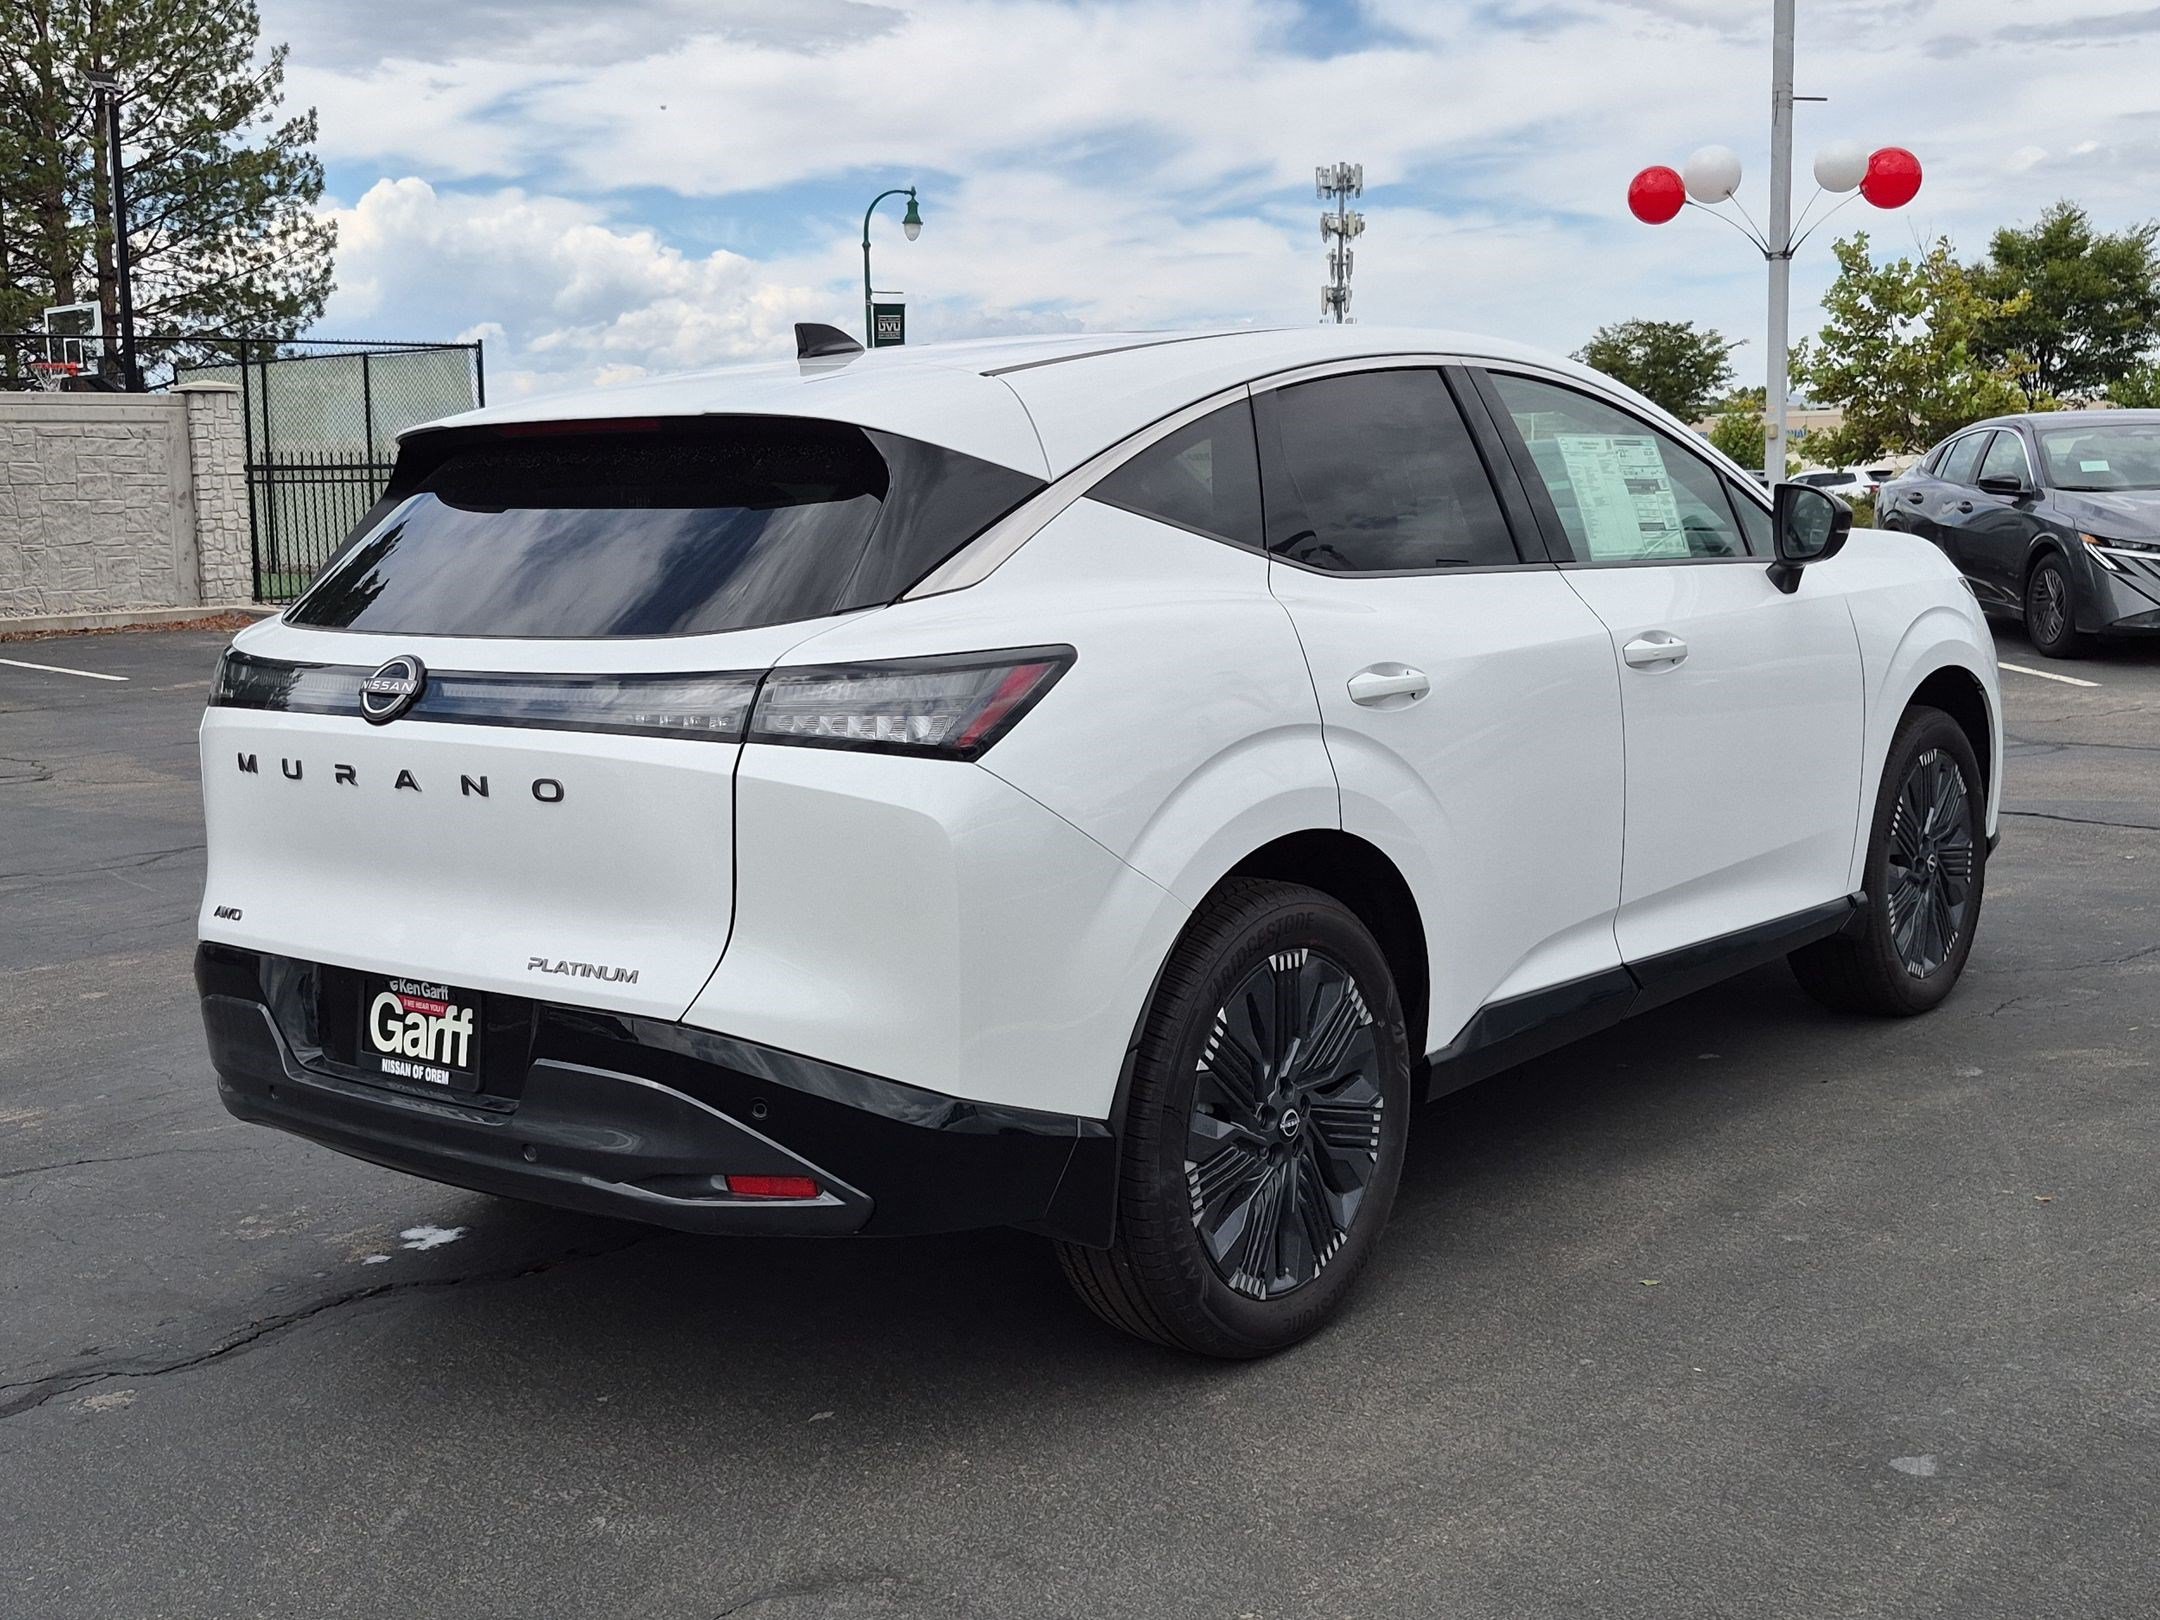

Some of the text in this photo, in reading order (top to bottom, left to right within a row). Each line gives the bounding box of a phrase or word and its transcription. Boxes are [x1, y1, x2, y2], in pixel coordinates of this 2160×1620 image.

[361, 680, 414, 692] NISSAN
[237, 752, 565, 803] MURANO
[213, 905, 243, 921] AWD
[527, 956, 640, 984] PLATINUM
[399, 979, 449, 1001] Ken Garff
[370, 991, 473, 1068] Garff
[381, 1058, 450, 1085] NISSAN OF OREM
